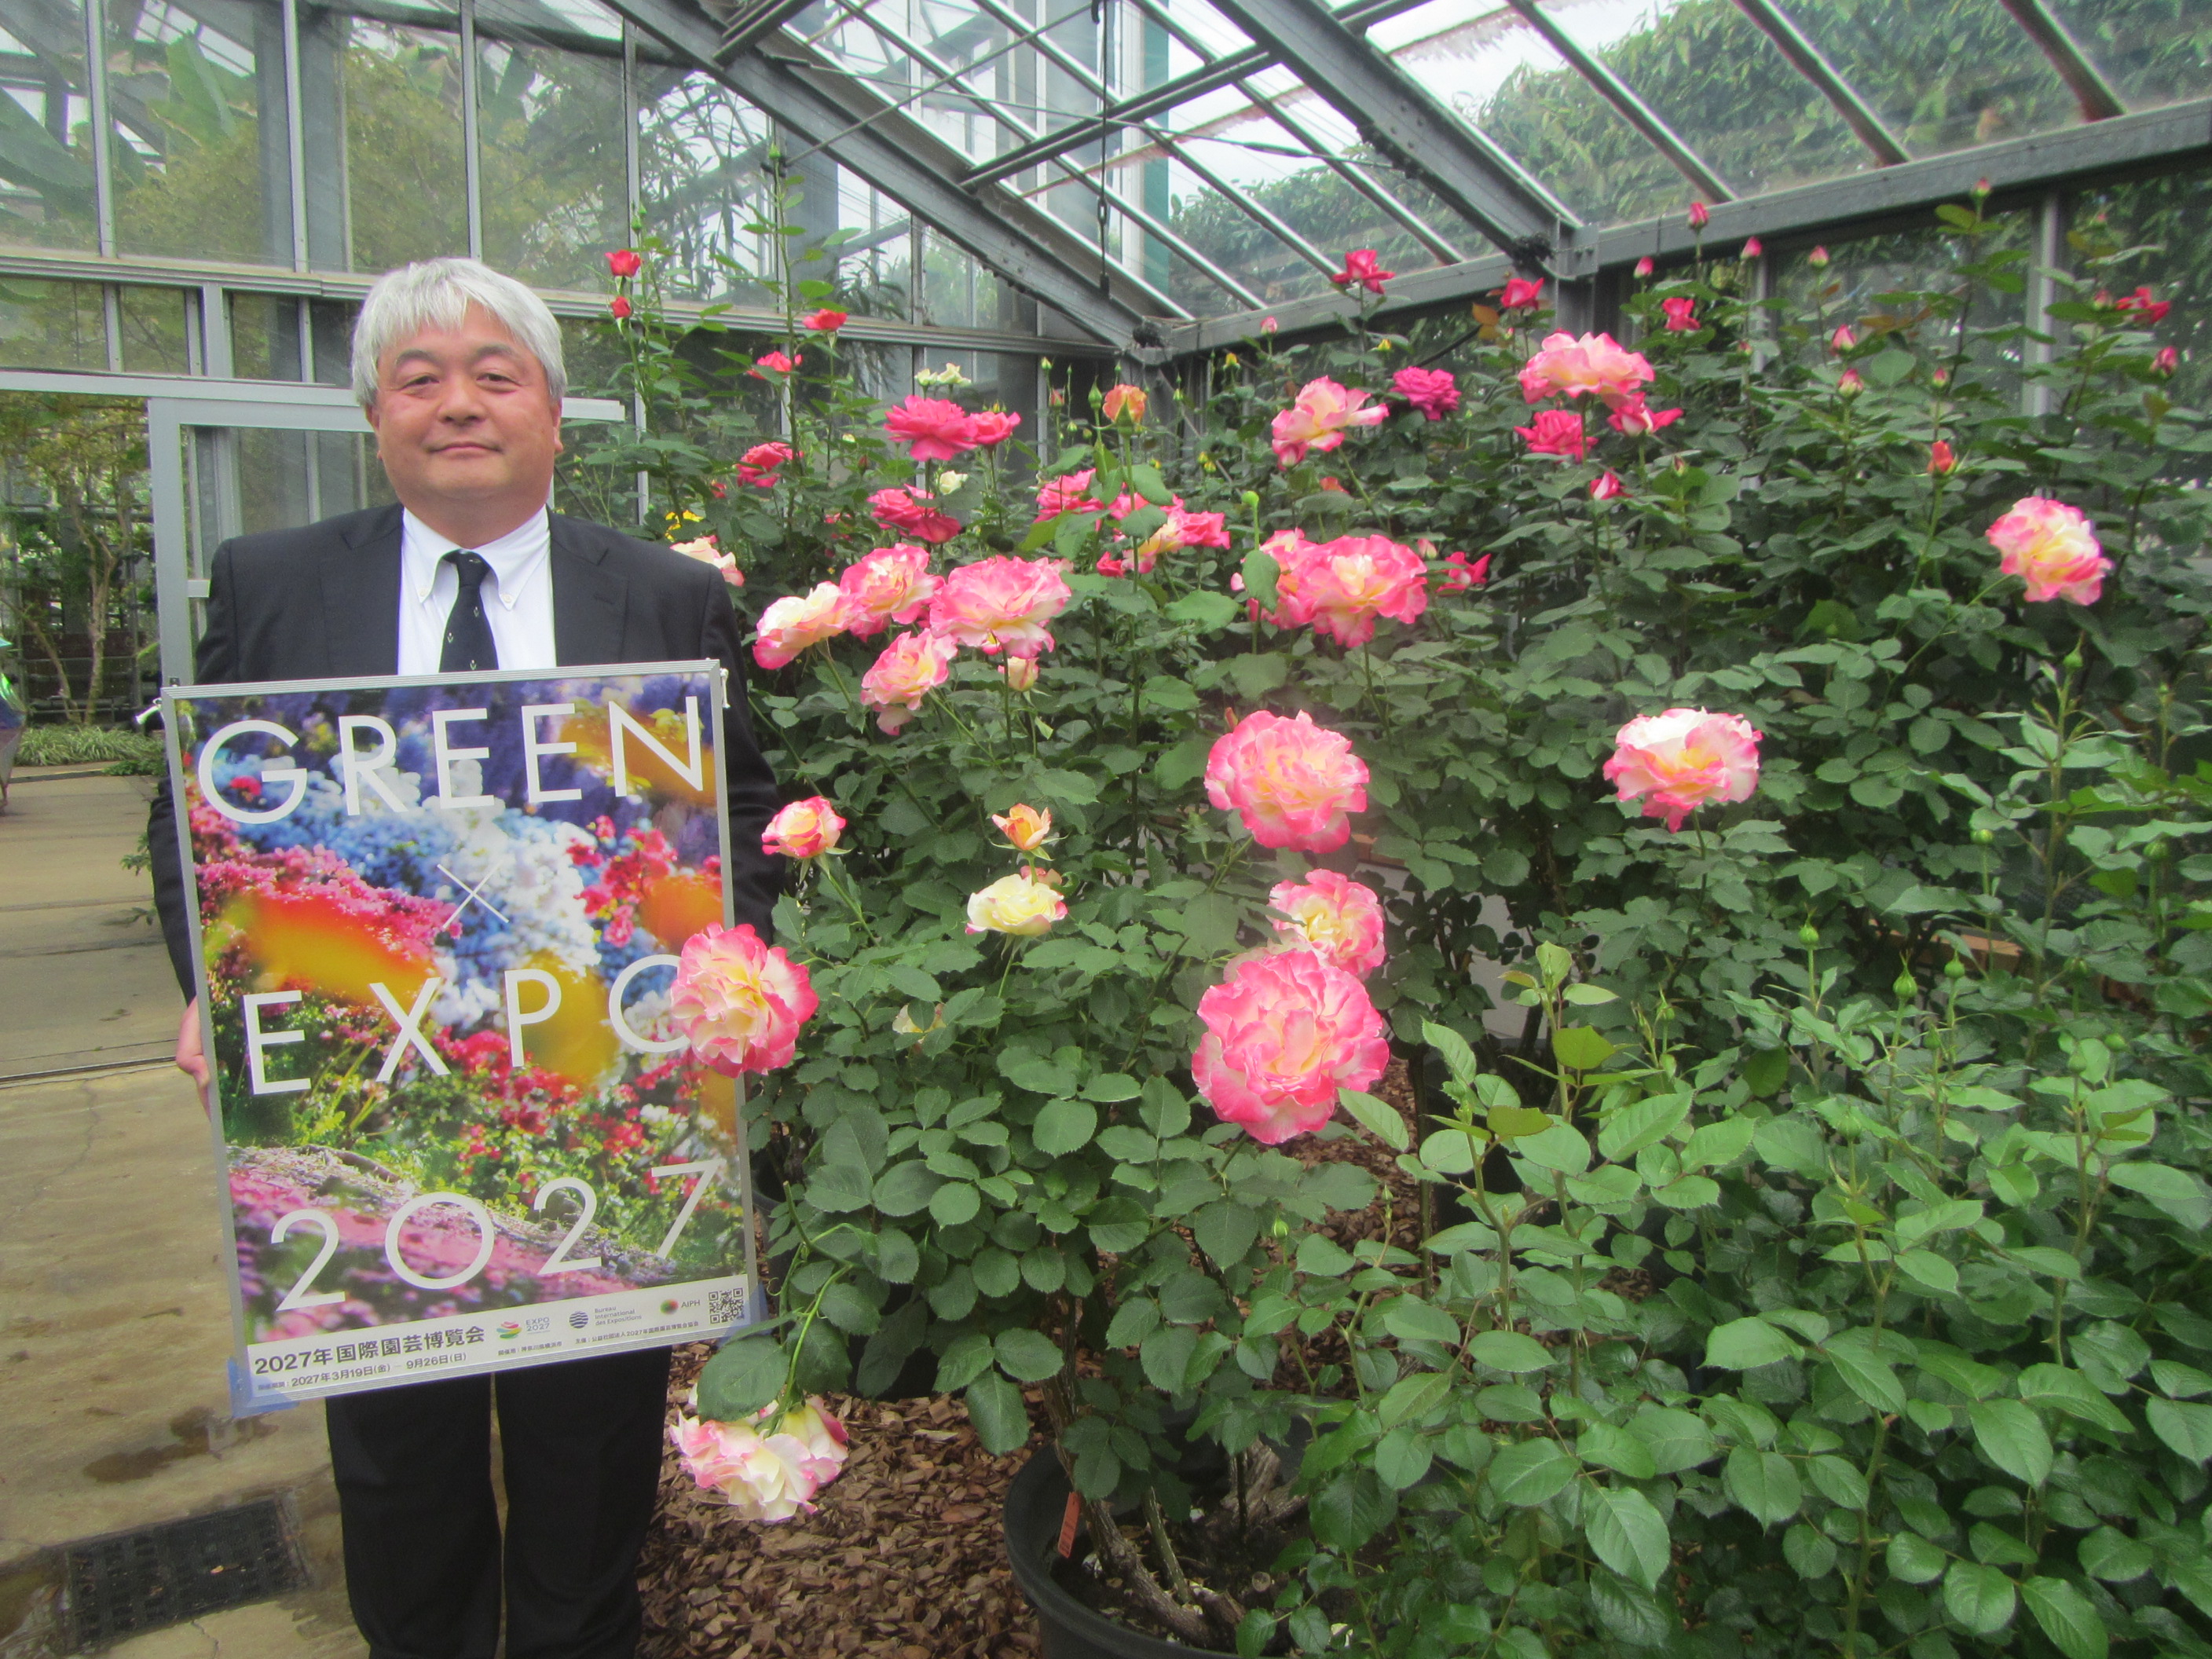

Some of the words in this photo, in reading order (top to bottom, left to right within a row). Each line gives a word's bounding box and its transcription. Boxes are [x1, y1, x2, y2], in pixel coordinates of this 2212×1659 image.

[198, 695, 703, 825] GREEN
[242, 954, 691, 1096] EXPO
[270, 1159, 727, 1312] 2027
[681, 1299, 701, 1309] AIPH
[595, 1309, 635, 1320] International
[607, 1314, 643, 1326] Expositions
[526, 1317, 550, 1325] EXPO
[526, 1323, 551, 1331] 2027
[255, 1326, 485, 1375] 2027年国際園芸博覧会
